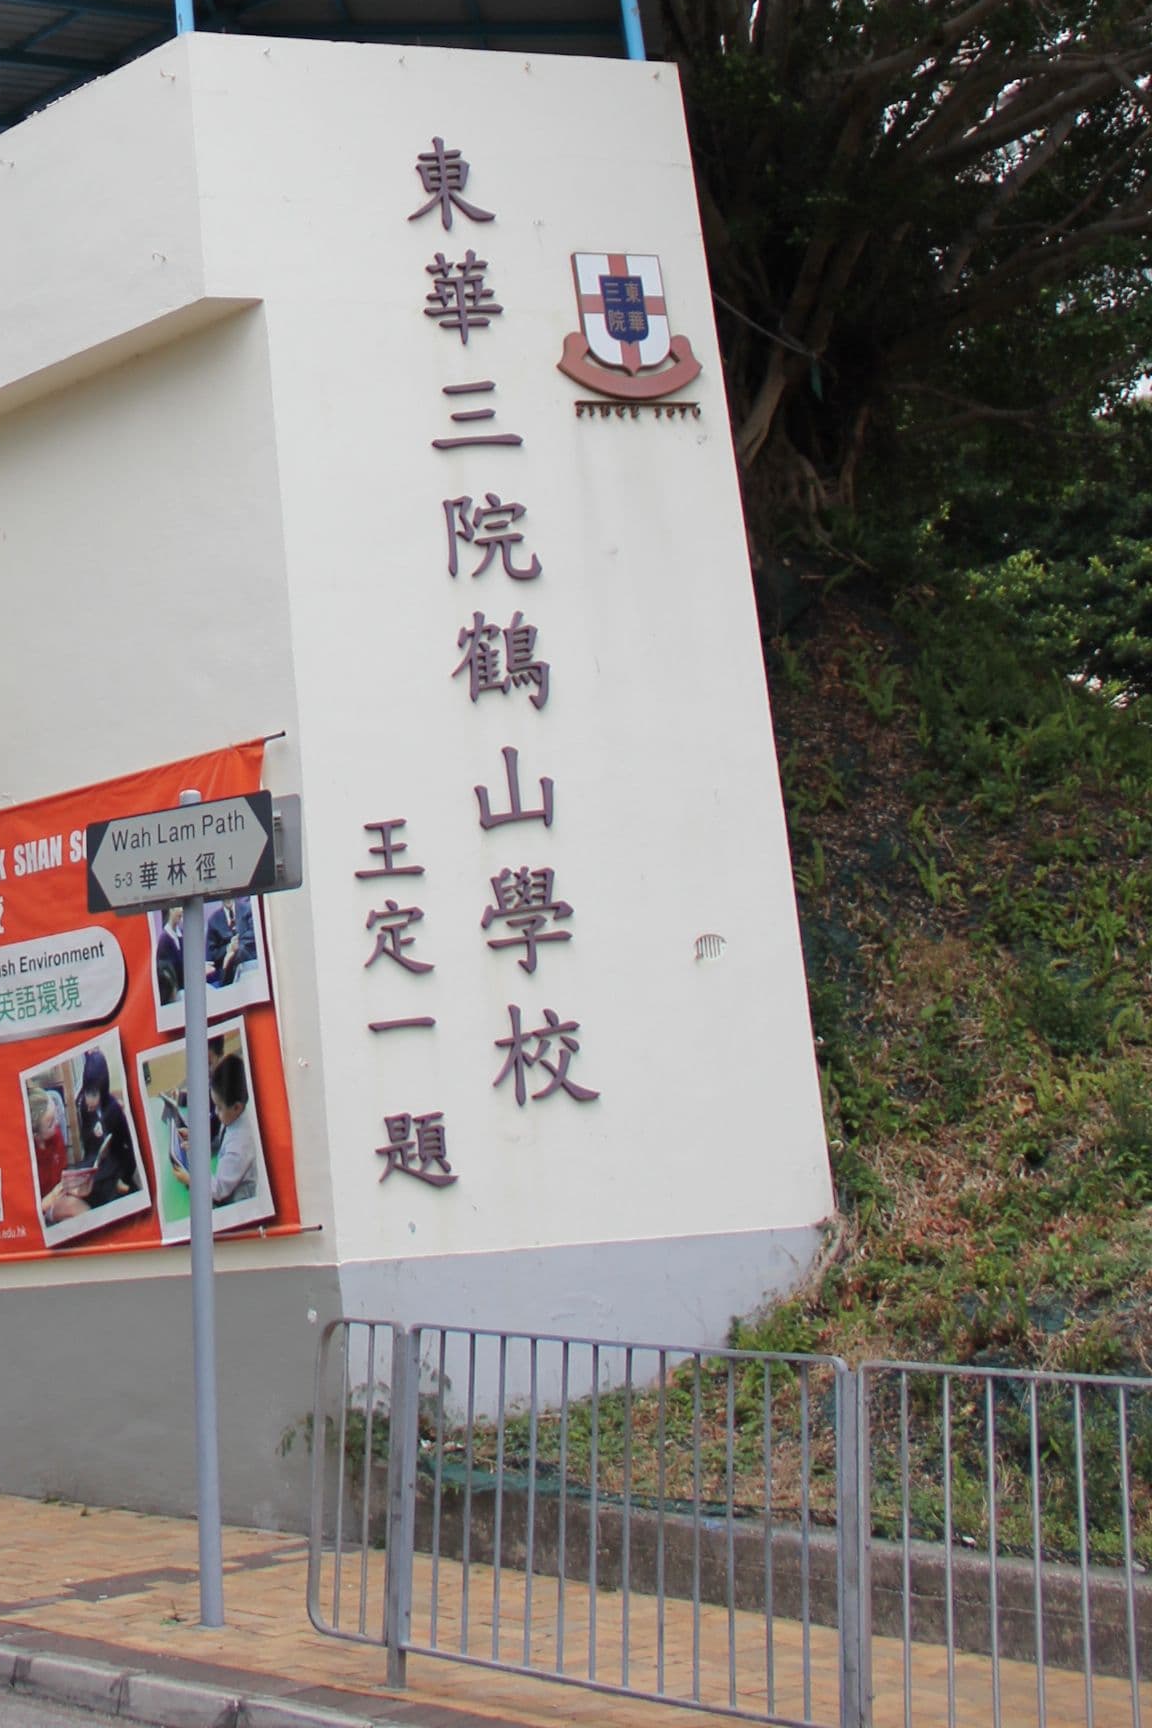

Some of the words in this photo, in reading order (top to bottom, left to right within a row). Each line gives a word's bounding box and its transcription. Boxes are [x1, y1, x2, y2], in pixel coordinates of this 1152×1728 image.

[408, 136, 600, 1106] 東華三院鶴山學校
[111, 828, 151, 853] Wah
[158, 822, 196, 845] Lam
[202, 810, 245, 836] Path
[13, 835, 63, 877] SHAN
[114, 872, 134, 889] 5-3
[139, 852, 218, 890] 華林徑
[228, 855, 234, 870] 1
[20, 941, 105, 973] Environment
